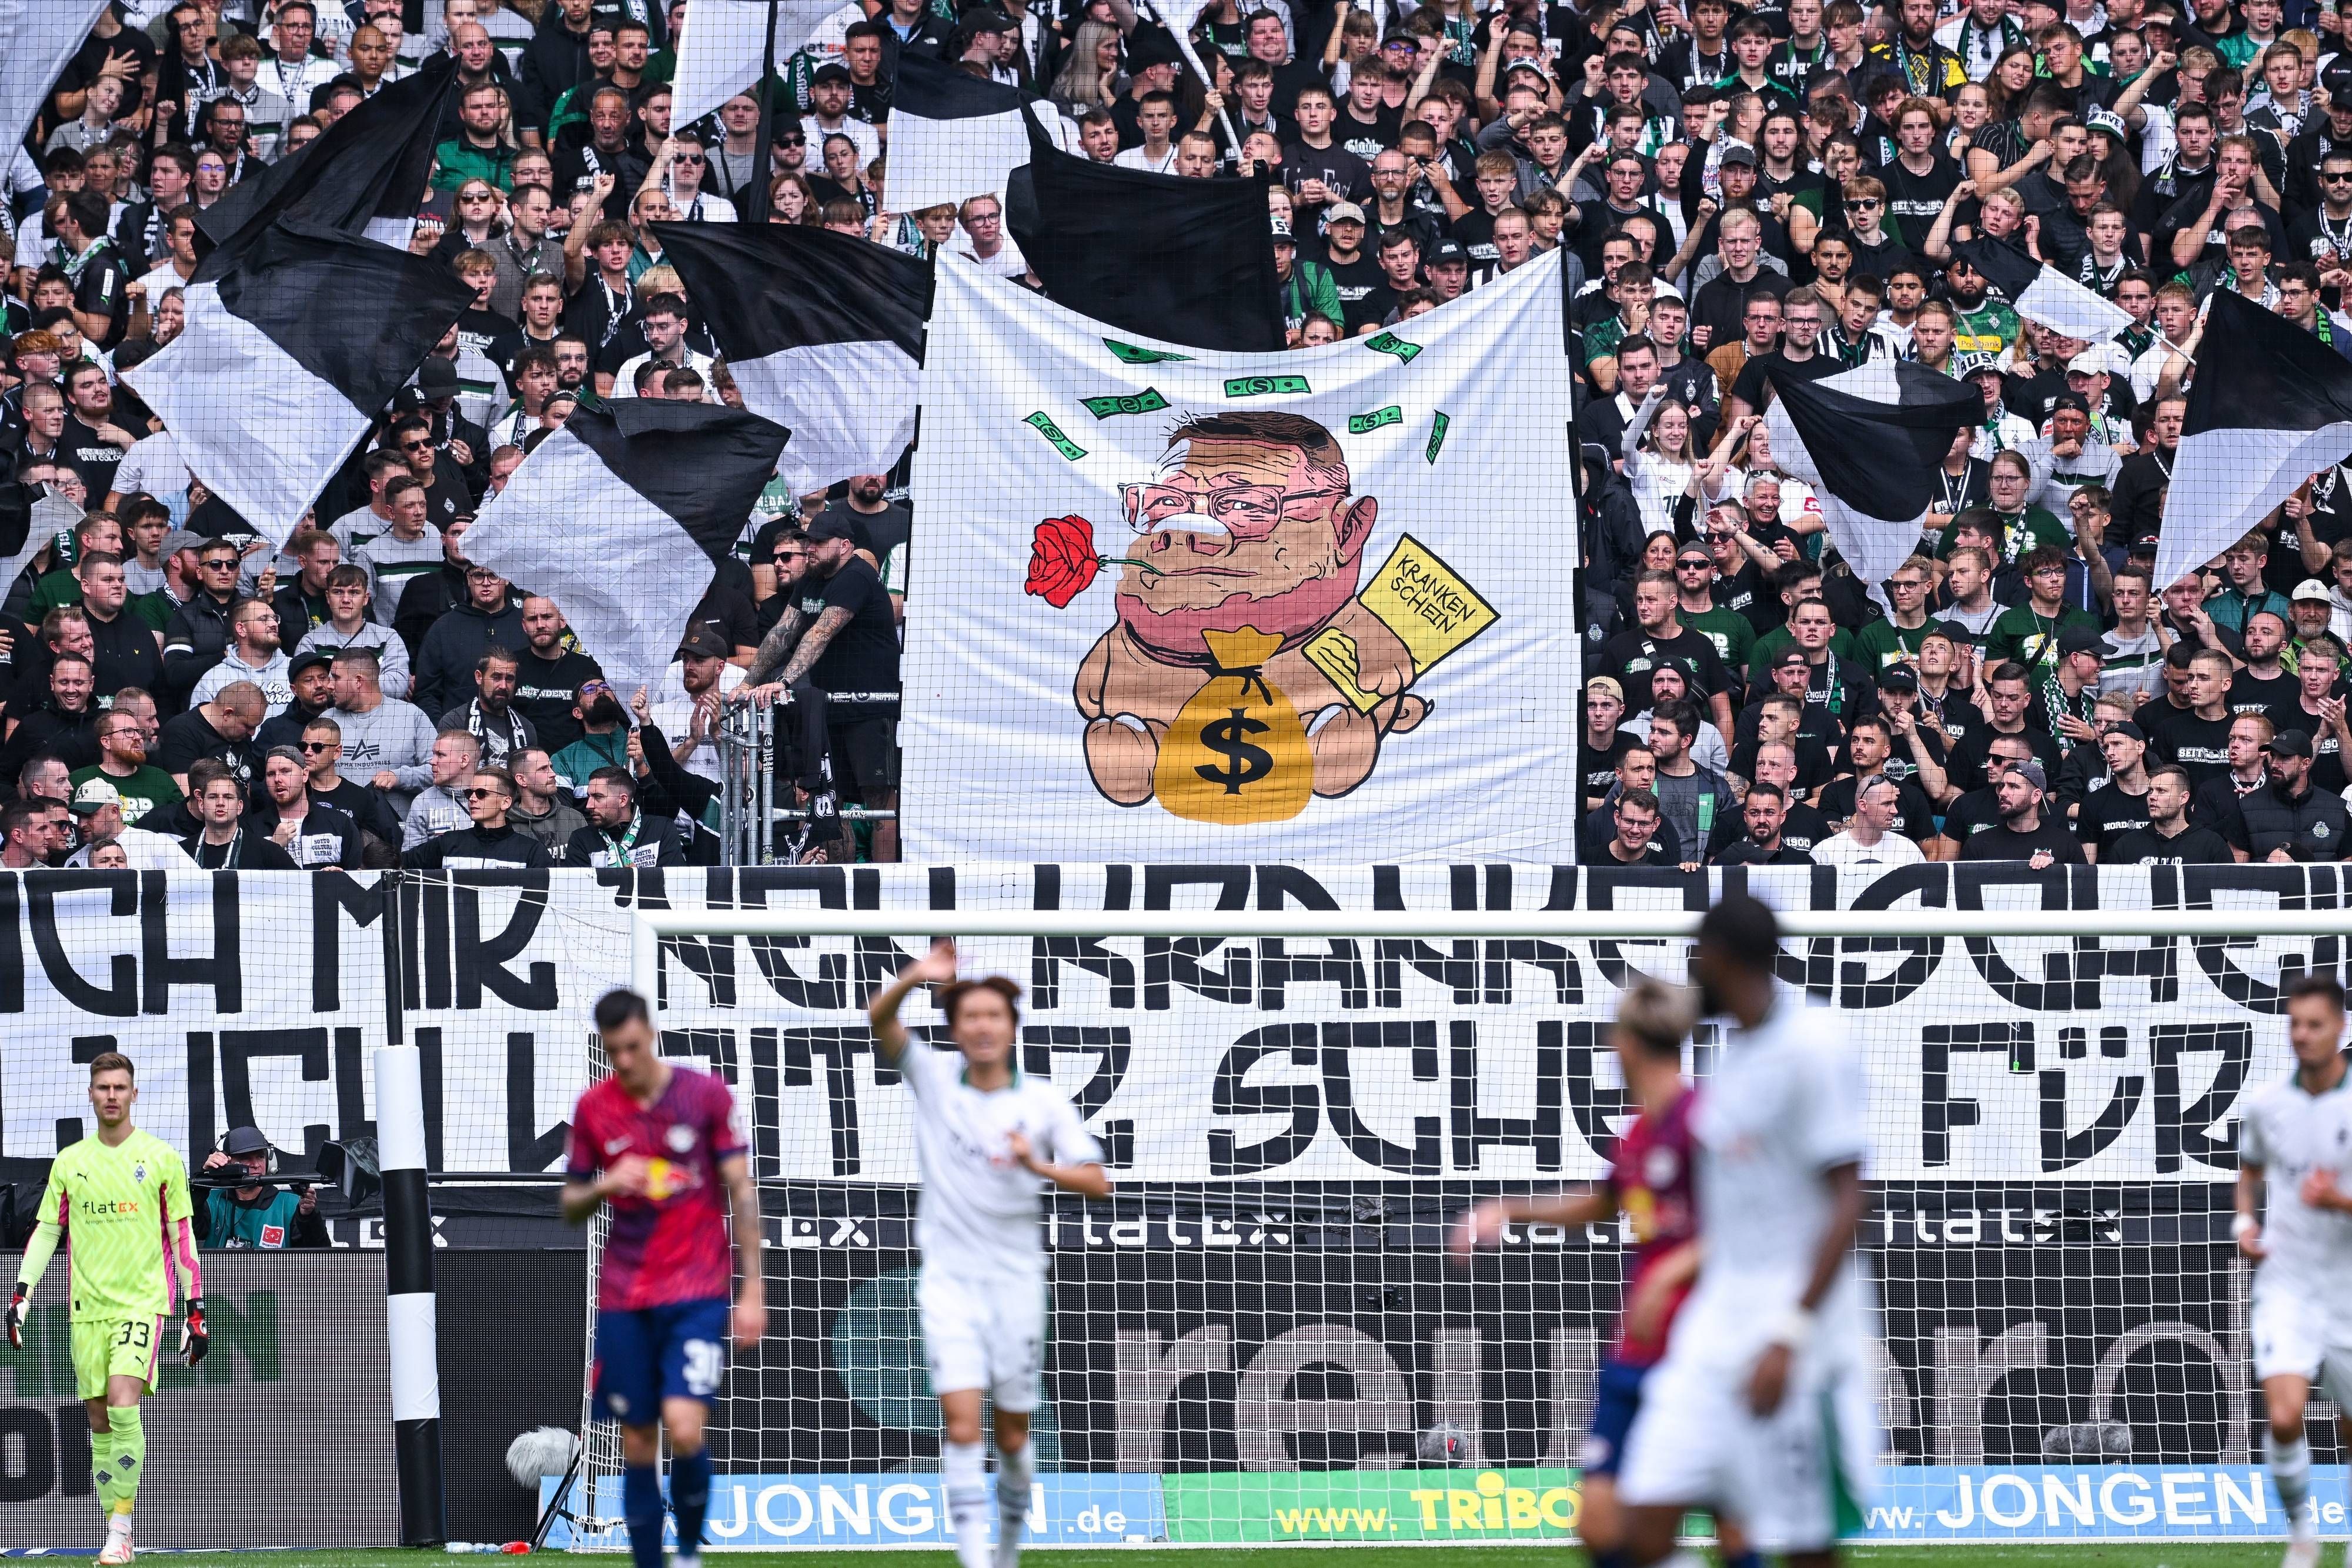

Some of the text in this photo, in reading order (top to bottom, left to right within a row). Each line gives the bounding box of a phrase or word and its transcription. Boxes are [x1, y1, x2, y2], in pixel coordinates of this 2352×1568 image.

[1927, 200, 1944, 210] 190
[413, 388, 425, 400] LA
[1395, 553, 1476, 620] KRANKEN
[1391, 577, 1457, 634] SCHEIN
[2321, 739, 2338, 750] 190
[2178, 748, 2201, 758] SEIT
[2103, 822, 2127, 830] NORD
[1785, 837, 1811, 848] 1900
[636, 849, 652, 857] SOTTO
[633, 855, 656, 863] CULTURA
[312, 869, 558, 1011] MIR
[1033, 862, 2352, 1015] KRANKENSCHEI
[118, 1321, 149, 1348] 33
[1936, 1472, 2267, 1529] JONGEN
[1275, 1507, 1398, 1533] www.
